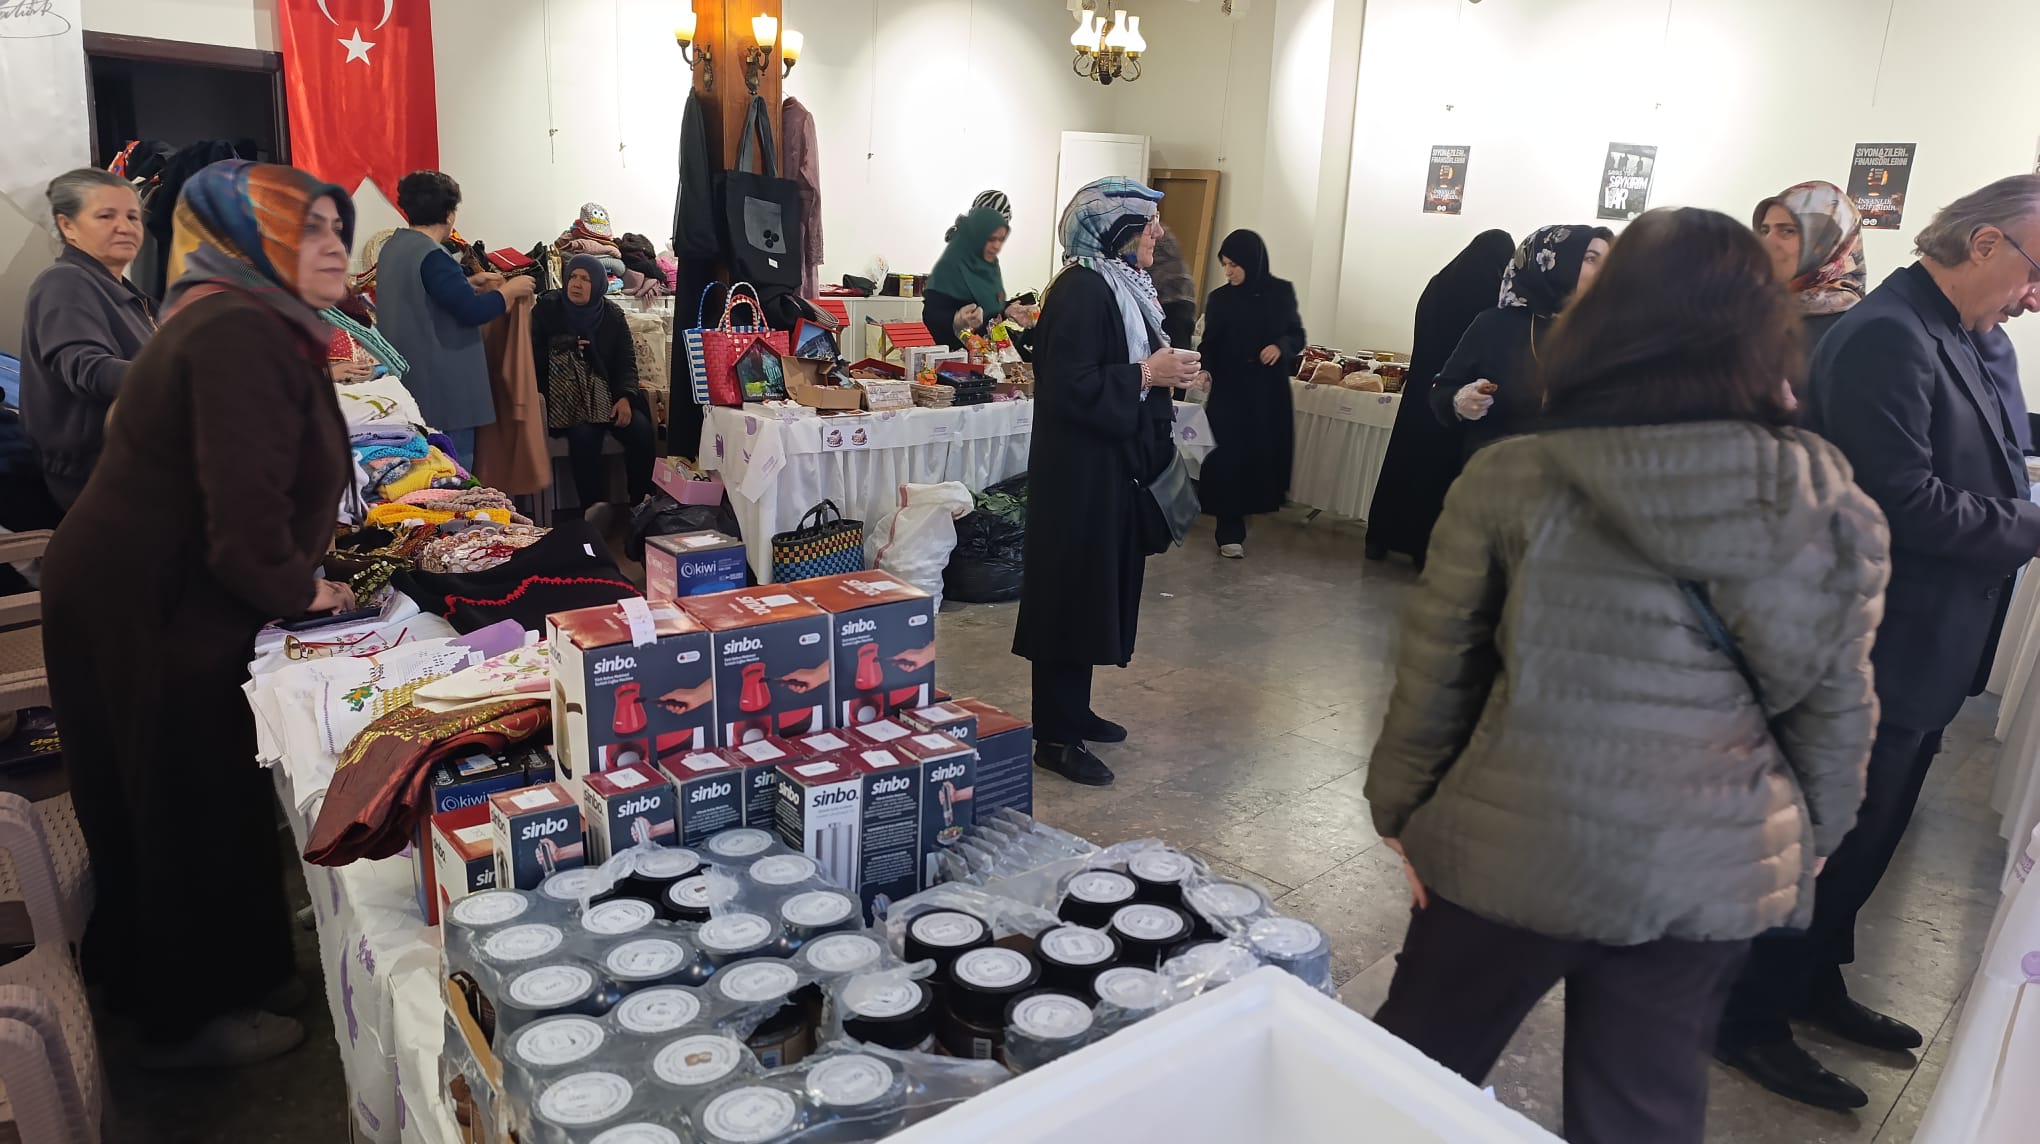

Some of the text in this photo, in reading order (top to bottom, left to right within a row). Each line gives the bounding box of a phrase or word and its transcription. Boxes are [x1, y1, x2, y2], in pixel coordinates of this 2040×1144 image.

[1605, 186, 1629, 210] VAR
[695, 561, 716, 575] kiwi
[930, 762, 965, 783] sinbo
[690, 782, 732, 803] sinbo
[779, 781, 800, 805] sinbo
[871, 775, 910, 796] sinbo
[460, 792, 487, 808] kiwi
[617, 795, 661, 818] sinbo
[521, 816, 568, 841] sinbo
